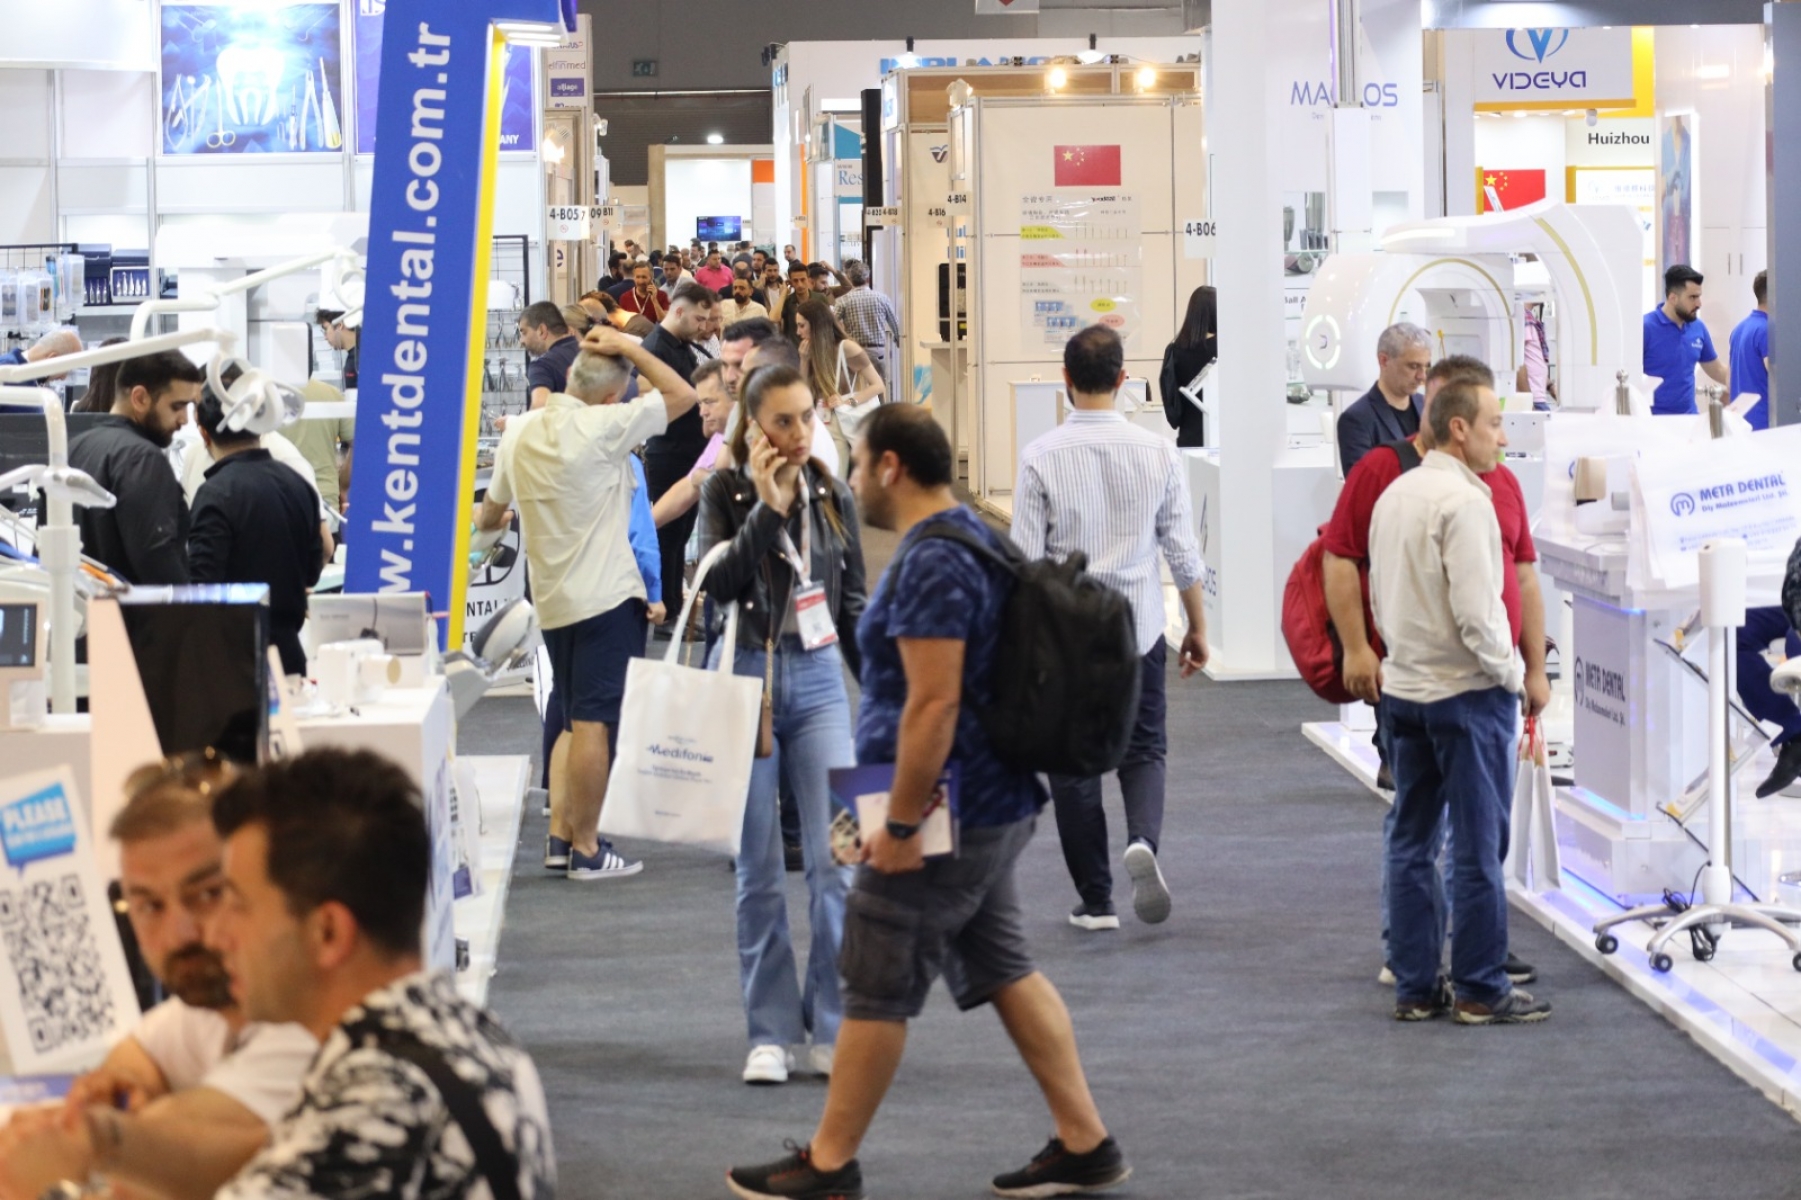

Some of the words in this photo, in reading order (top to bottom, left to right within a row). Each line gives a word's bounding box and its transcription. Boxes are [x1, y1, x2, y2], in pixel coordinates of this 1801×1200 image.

[1587, 131, 1651, 145] Huizhou
[947, 194, 967, 204] 4-B14
[549, 207, 579, 221] 4-B05
[928, 208, 946, 217] 4-B16
[1699, 483, 1735, 502] META
[1737, 473, 1786, 494] DENTAL
[1602, 667, 1625, 702] DENTAL
